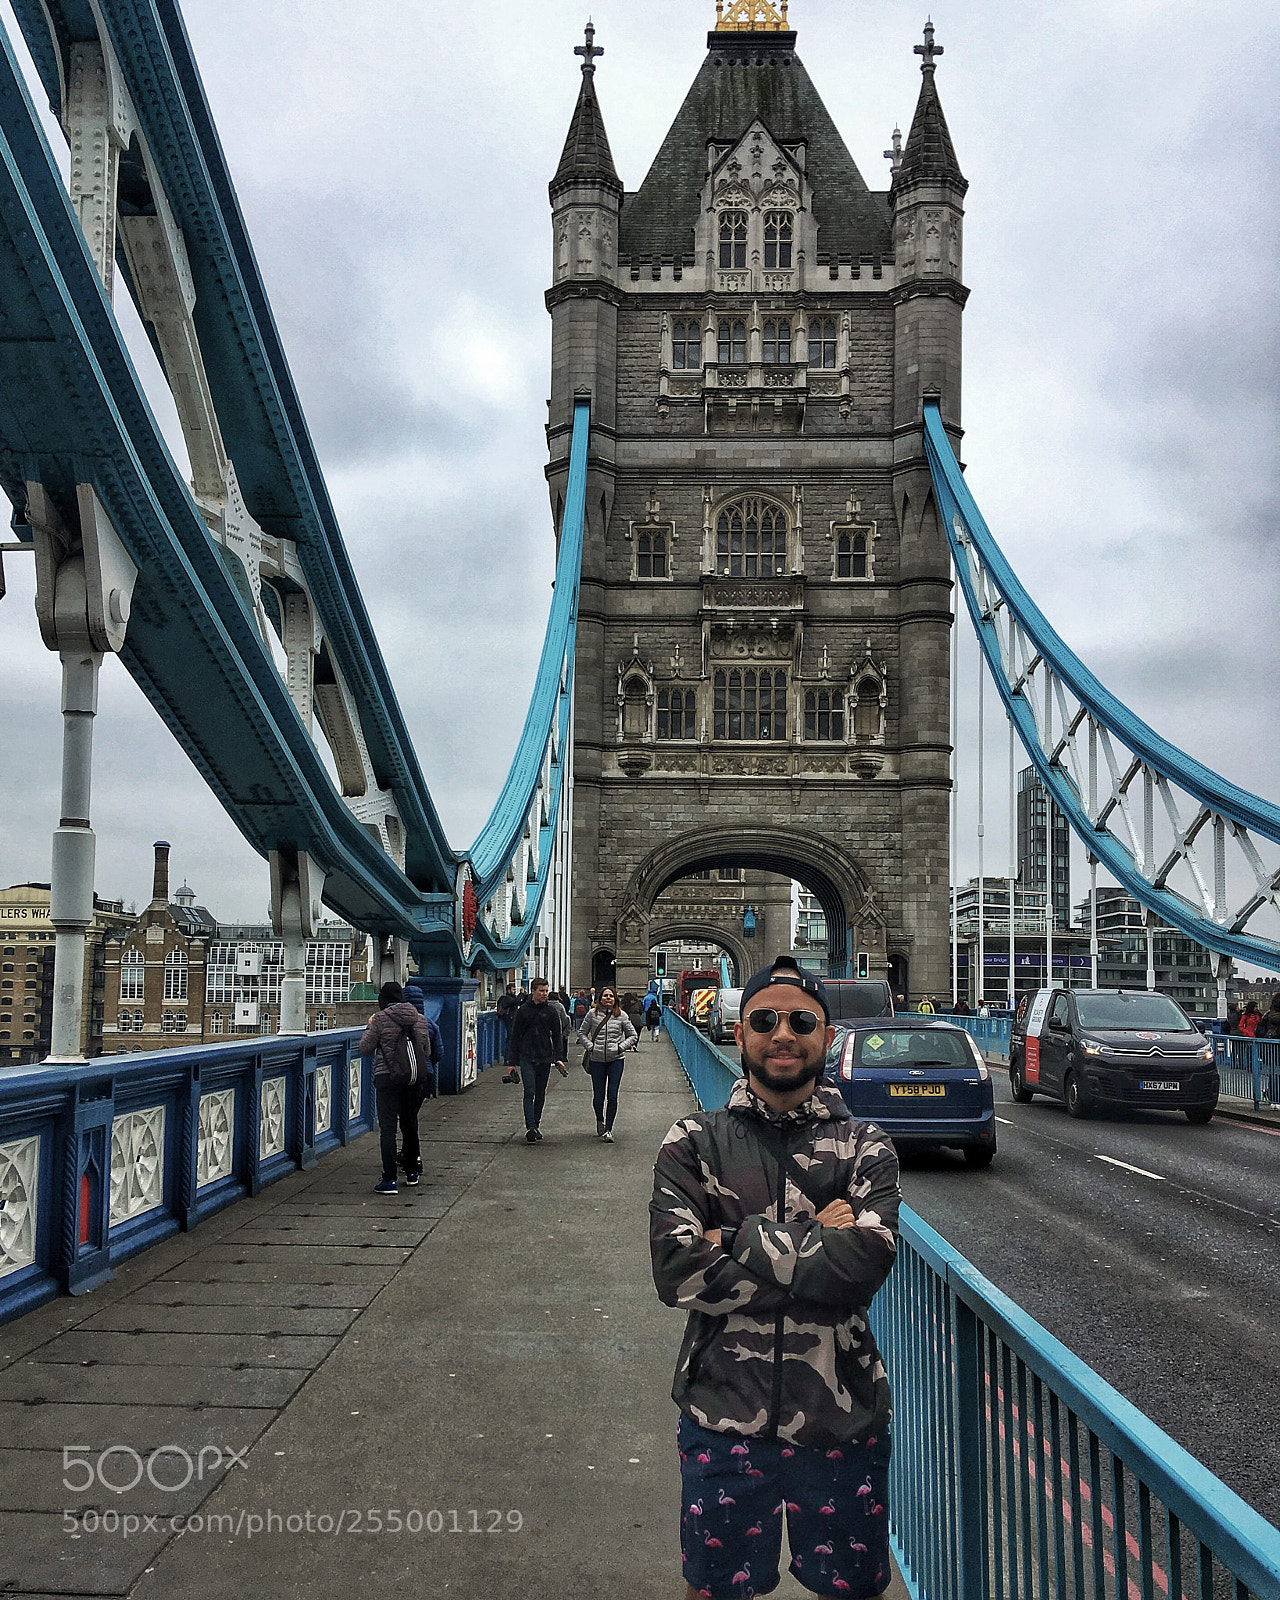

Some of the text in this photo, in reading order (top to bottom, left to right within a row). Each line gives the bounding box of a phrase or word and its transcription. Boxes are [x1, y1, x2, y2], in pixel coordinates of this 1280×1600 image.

[0, 908, 51, 919] LER'S WHA
[894, 1085, 941, 1095] YT58 PJO
[1143, 1082, 1162, 1090] HX67
